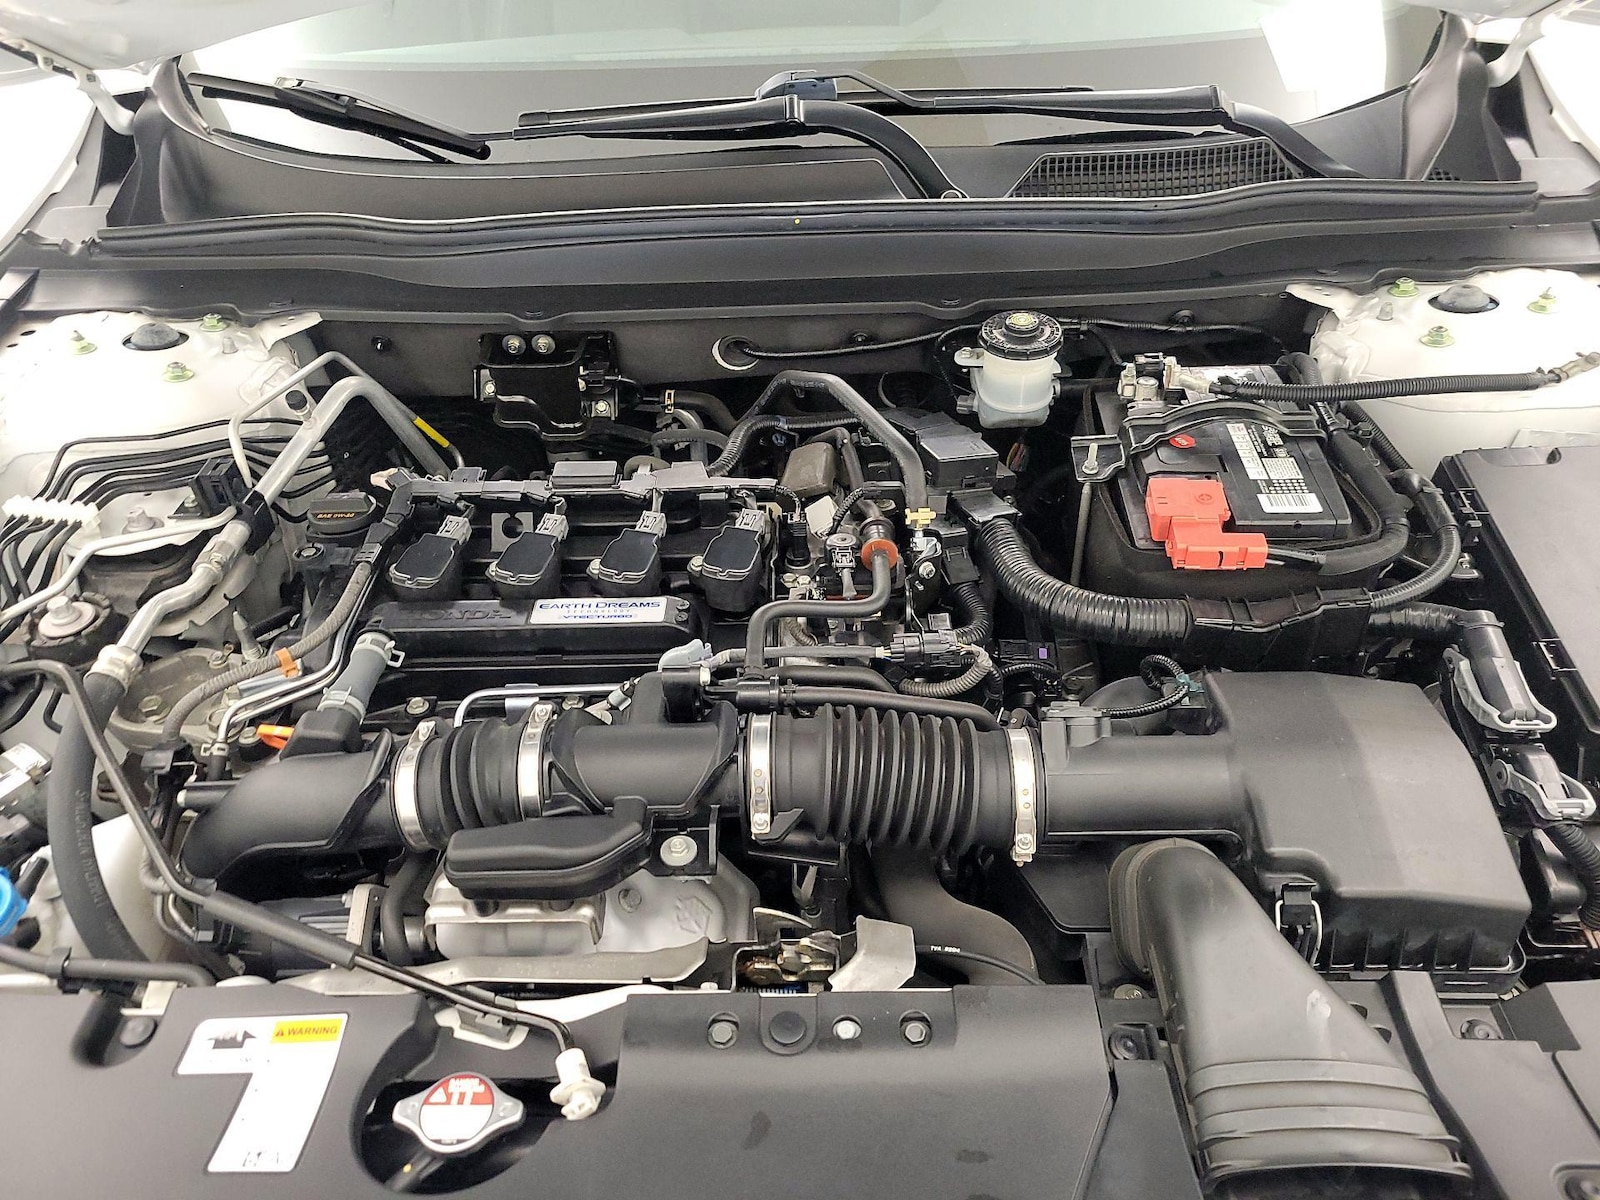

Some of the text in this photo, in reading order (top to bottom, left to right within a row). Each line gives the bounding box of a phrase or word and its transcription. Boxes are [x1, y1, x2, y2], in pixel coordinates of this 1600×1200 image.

[539, 601, 661, 610] EARTH DREAMS
[287, 1025, 339, 1037] WARNING
